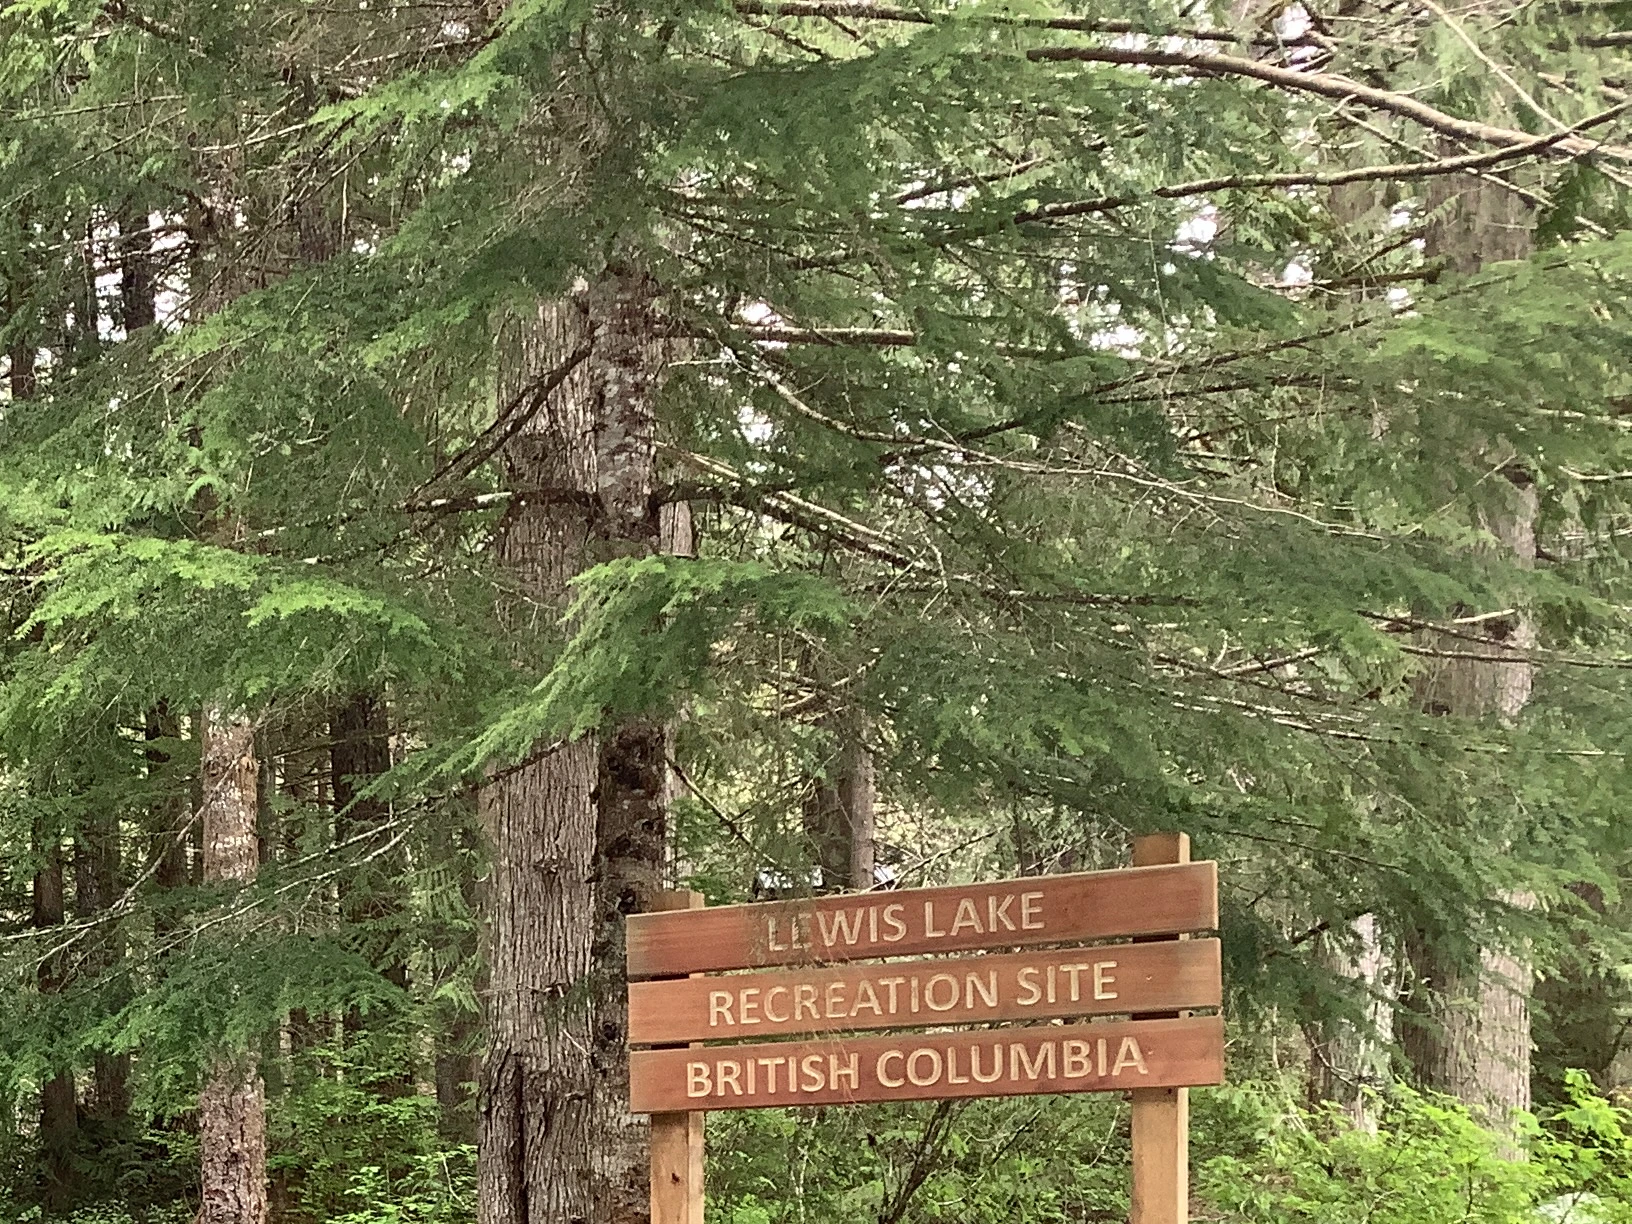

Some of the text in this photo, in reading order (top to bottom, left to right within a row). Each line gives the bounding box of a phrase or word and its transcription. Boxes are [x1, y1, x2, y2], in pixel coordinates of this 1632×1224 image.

[767, 891, 1045, 952] LEWIS LAKE
[708, 960, 1119, 1027] RECREATION SITE
[686, 1036, 1149, 1099] BRITISH COLUMBIA
